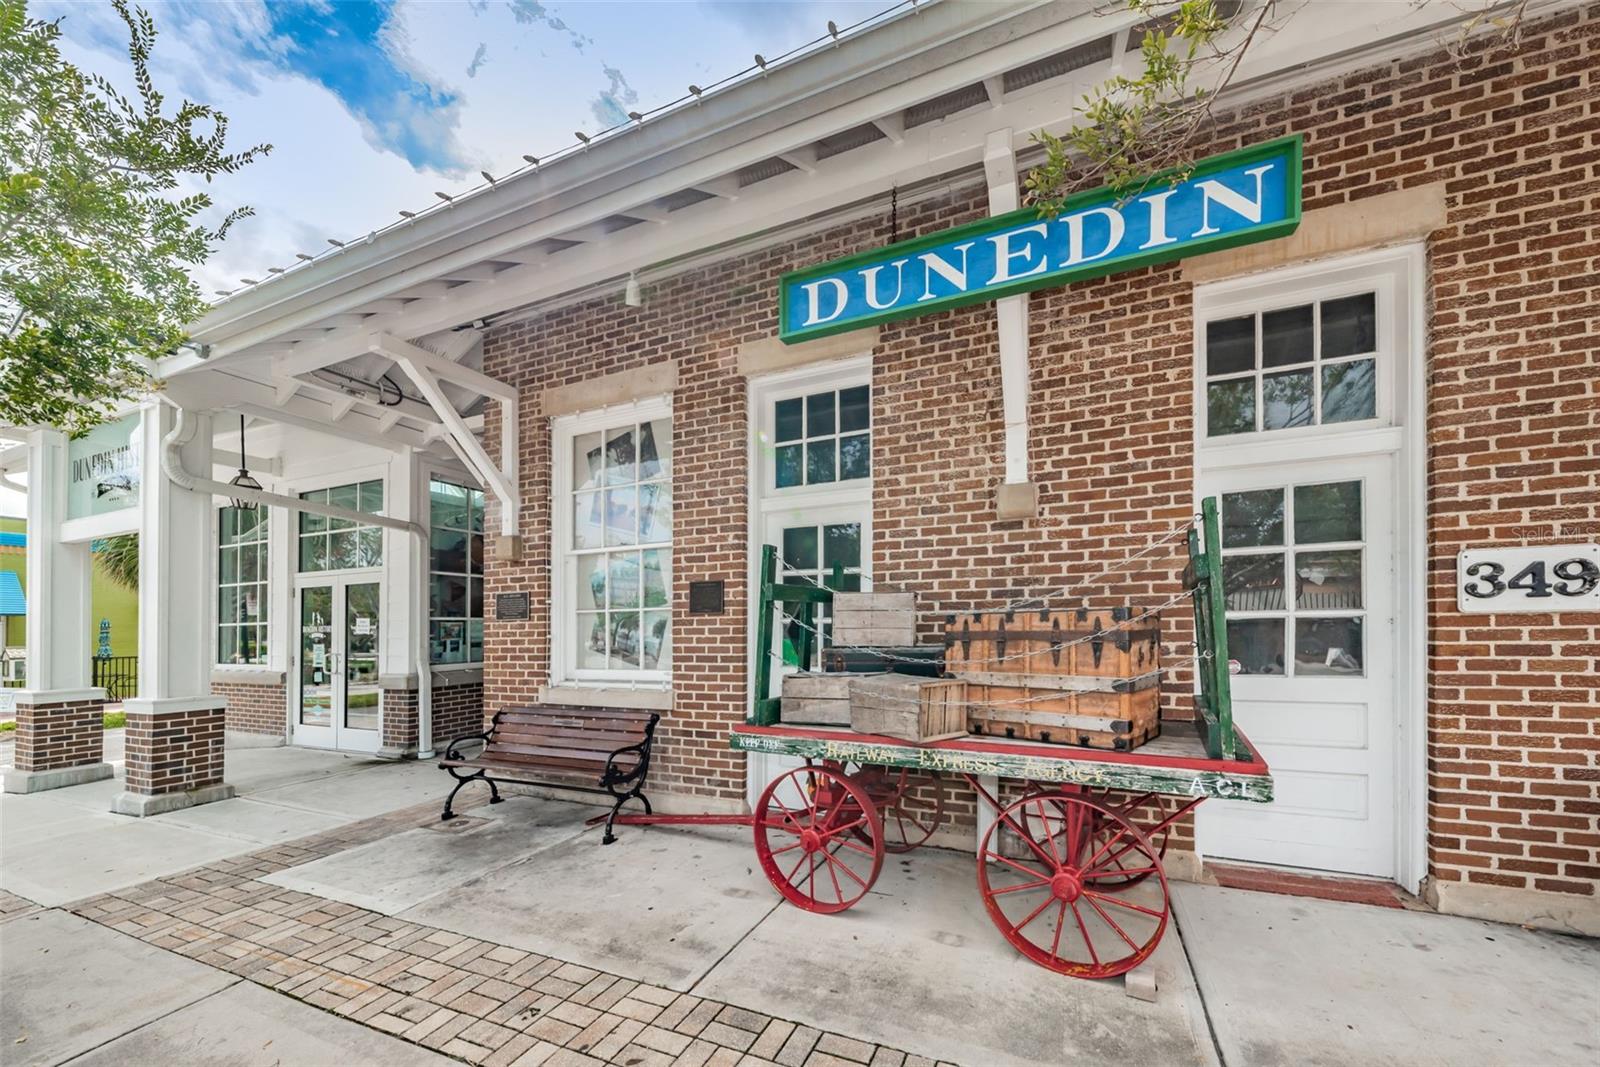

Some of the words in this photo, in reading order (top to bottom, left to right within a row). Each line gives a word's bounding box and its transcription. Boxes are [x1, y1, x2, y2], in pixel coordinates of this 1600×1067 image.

[801, 163, 1275, 328] DUNEDIN
[72, 449, 114, 483] DUNEDIN
[1464, 557, 1600, 598] 349
[826, 741, 896, 763] RAILWAY
[918, 748, 1000, 773] EXPRESS
